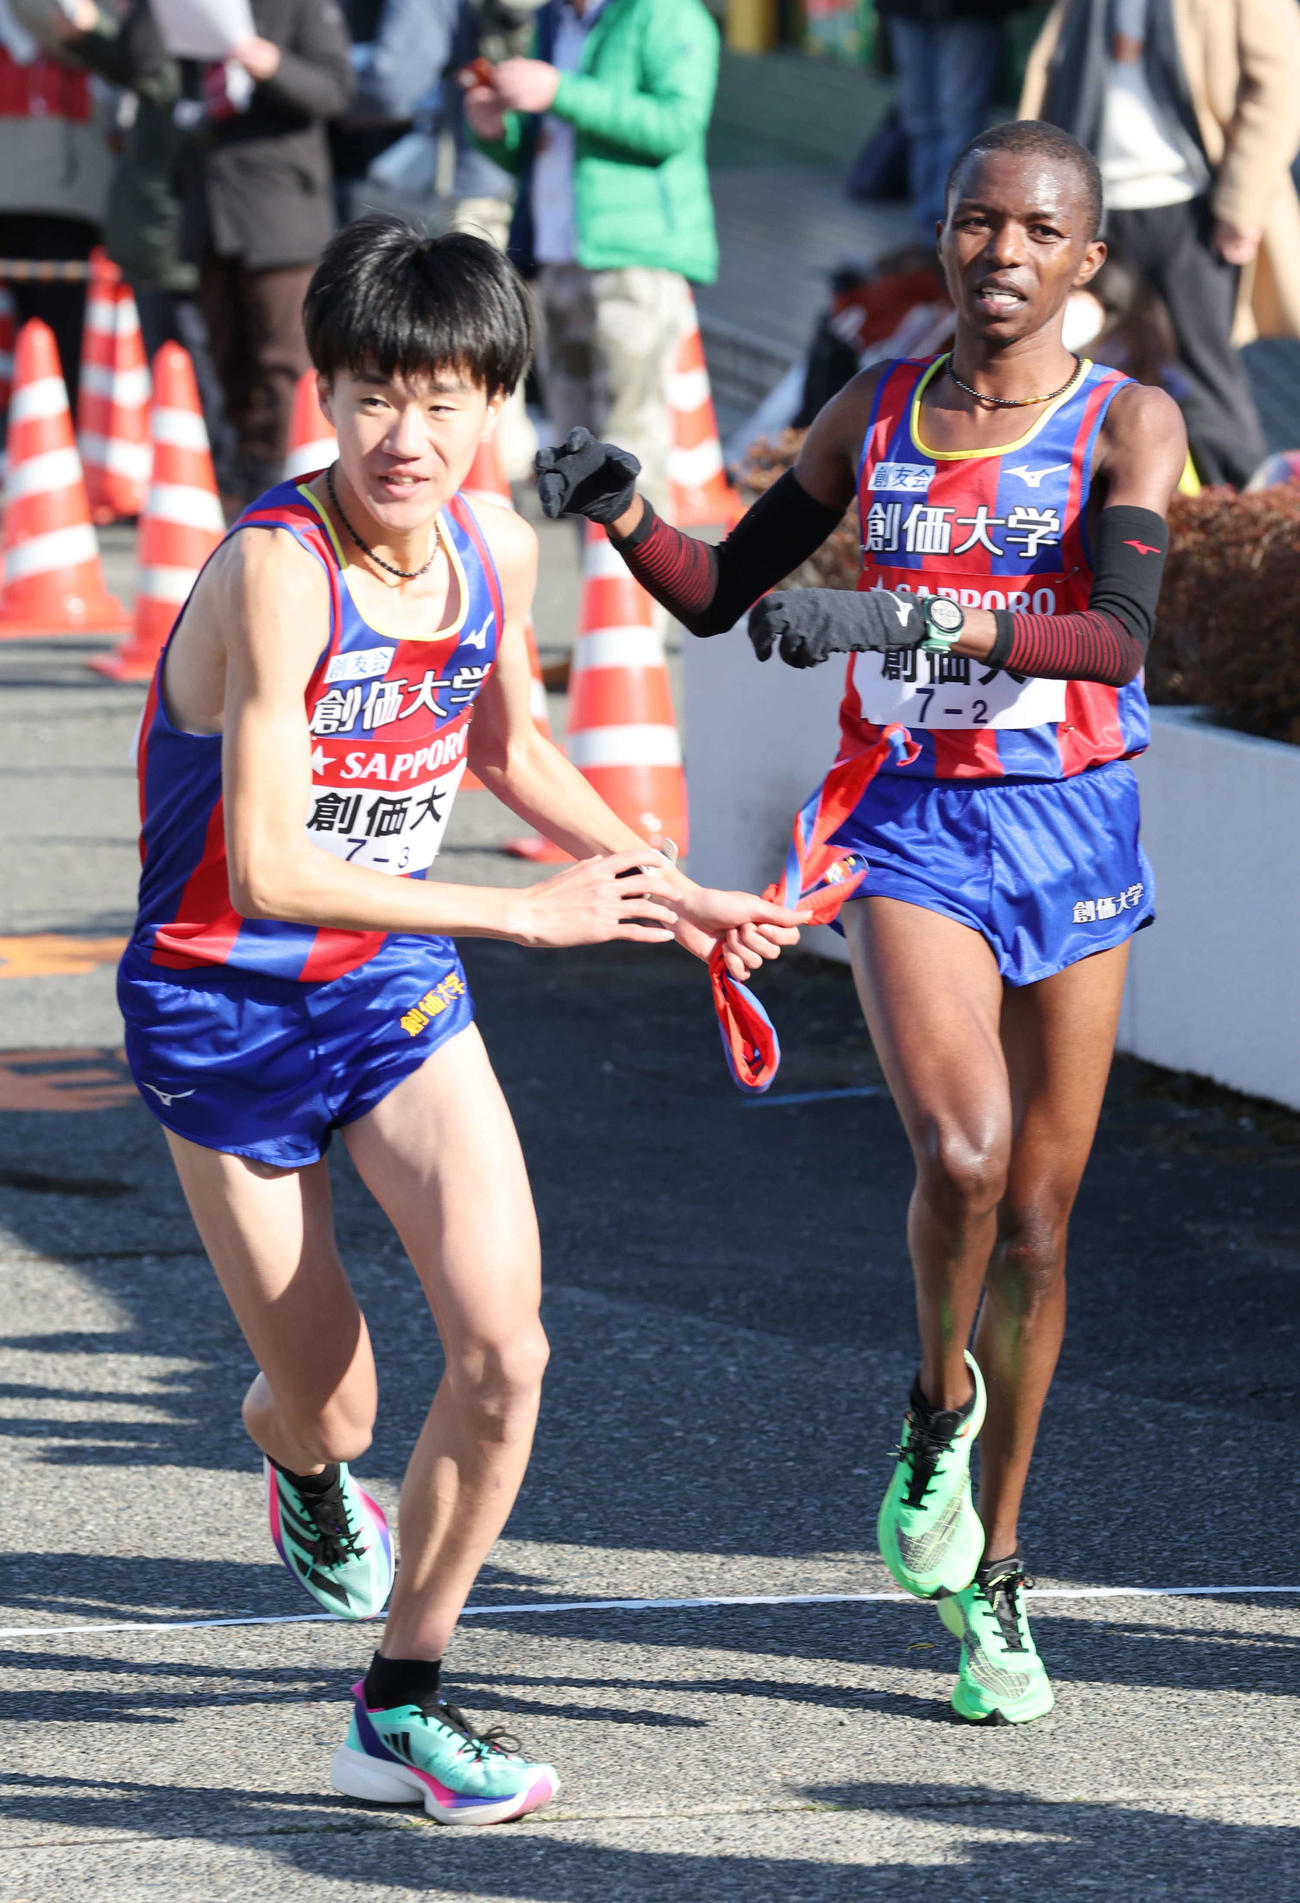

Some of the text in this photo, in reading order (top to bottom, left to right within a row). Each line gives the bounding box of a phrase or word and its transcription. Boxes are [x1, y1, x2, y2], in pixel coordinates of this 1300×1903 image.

[864, 503, 1060, 557] 創価大学
[895, 583, 1056, 616] PORO
[881, 650, 1027, 686] 創価
[306, 785, 446, 838] 創価大
[1072, 883, 1144, 924] 創価大学
[400, 973, 465, 1036] 創価大学
